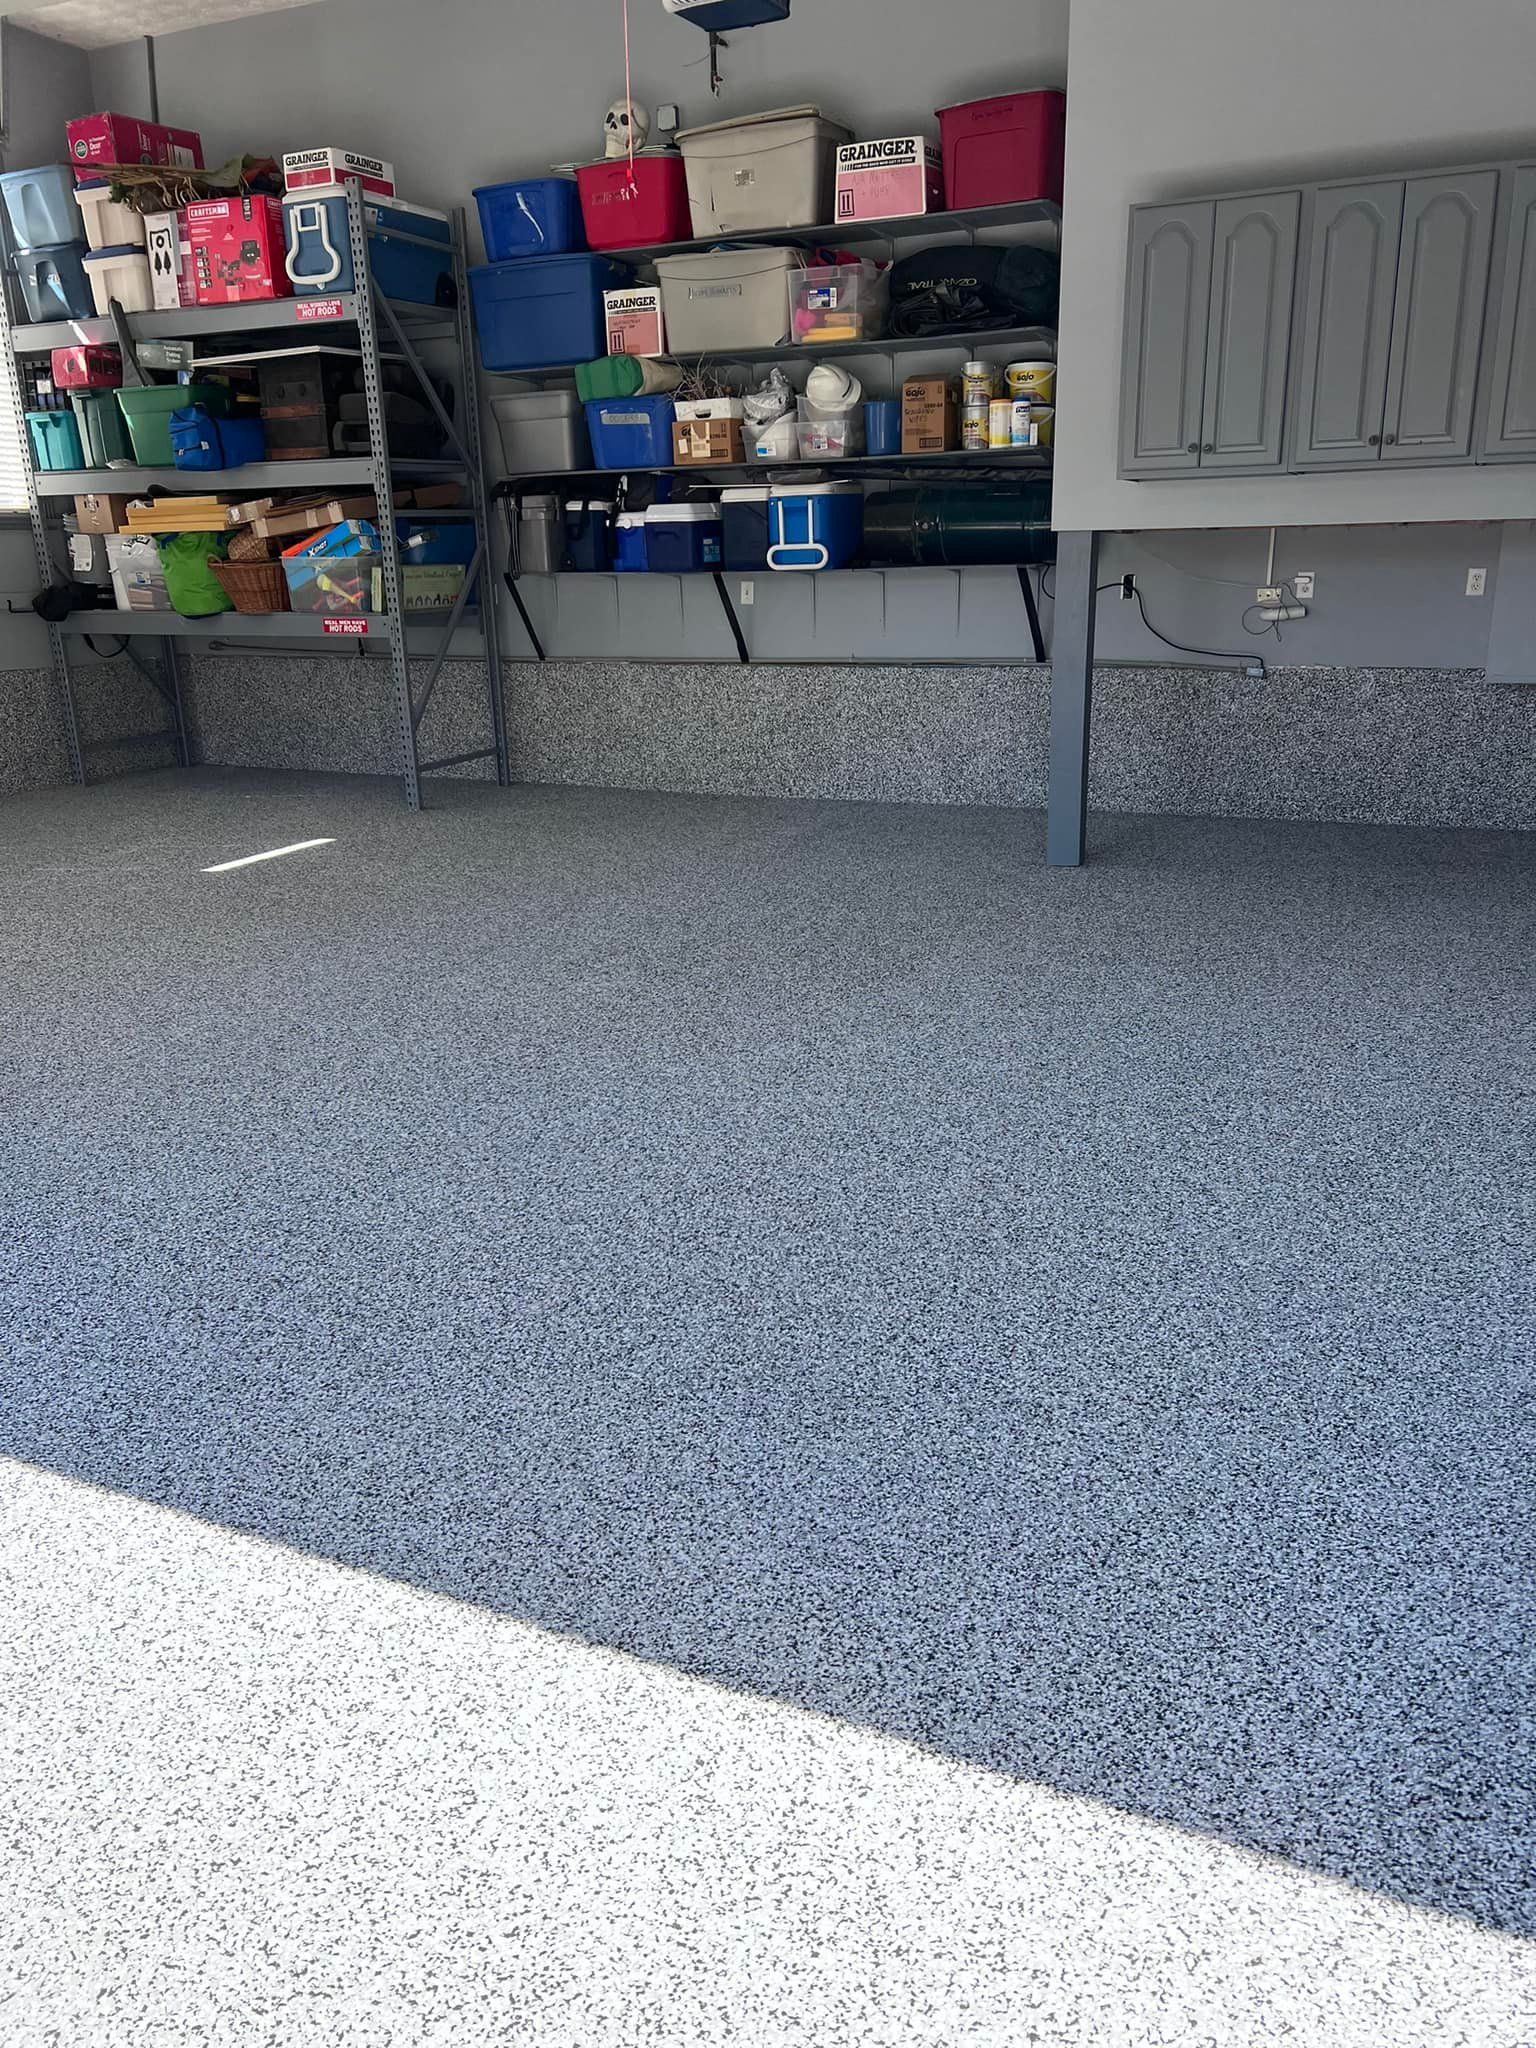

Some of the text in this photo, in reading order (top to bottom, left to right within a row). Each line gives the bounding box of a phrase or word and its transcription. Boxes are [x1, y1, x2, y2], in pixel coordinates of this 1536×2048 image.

[840, 139, 916, 163] GRAINGER
[285, 151, 329, 166] GRAINGER
[345, 154, 384, 173] GRAINGER
[190, 205, 227, 217] CRAFTSMAN
[607, 296, 657, 310] GRAINGER
[302, 306, 337, 318] HOT RODS
[329, 624, 362, 633] HOT RODS
